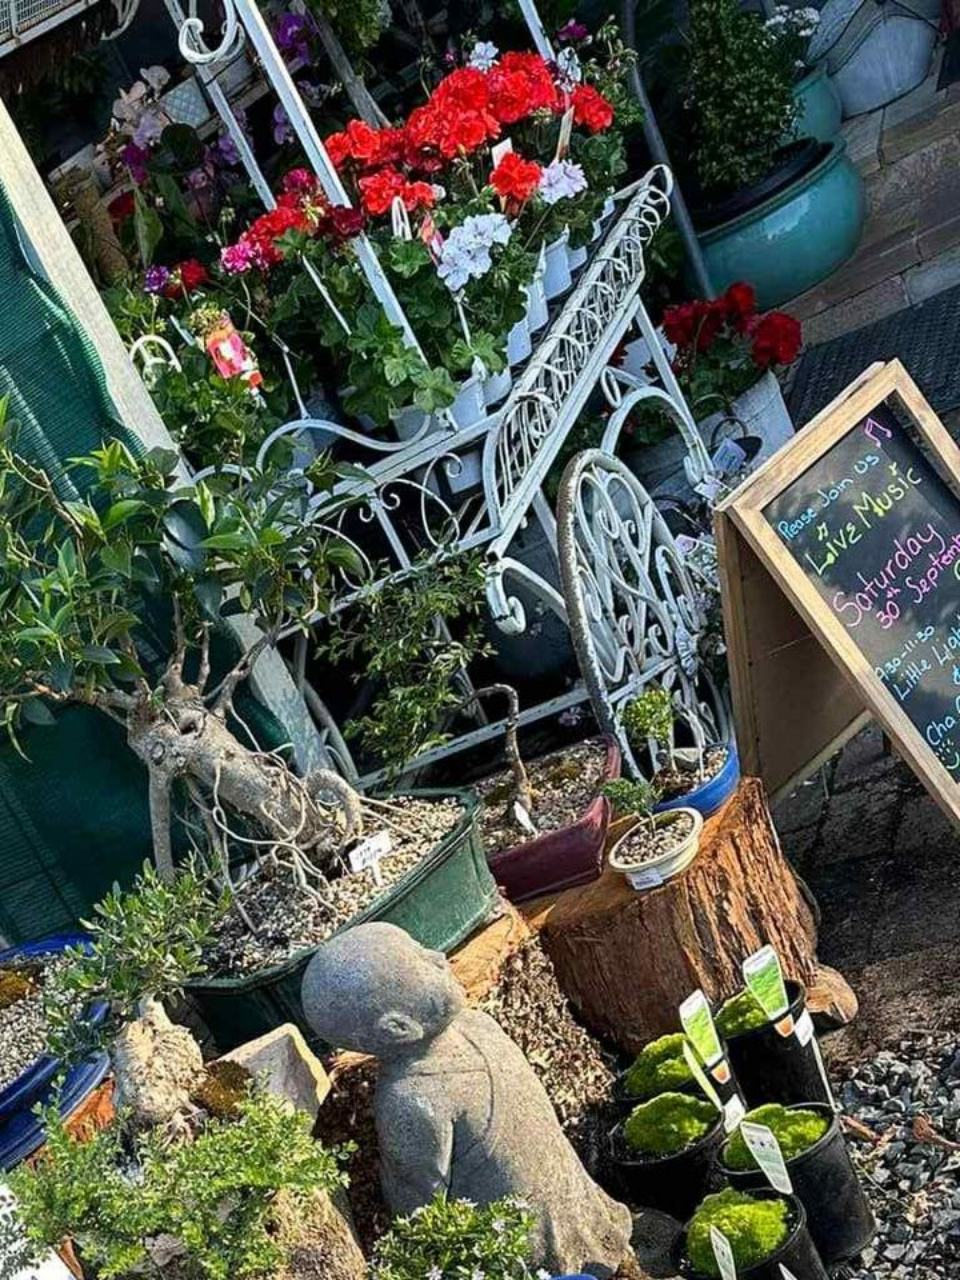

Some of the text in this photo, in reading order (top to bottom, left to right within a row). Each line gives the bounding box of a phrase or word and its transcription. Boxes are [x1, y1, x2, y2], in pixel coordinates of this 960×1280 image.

[778, 507, 817, 541] Please
[833, 523, 946, 628] Saturday
[893, 659, 932, 701] Little
[926, 714, 956, 746] Cha
